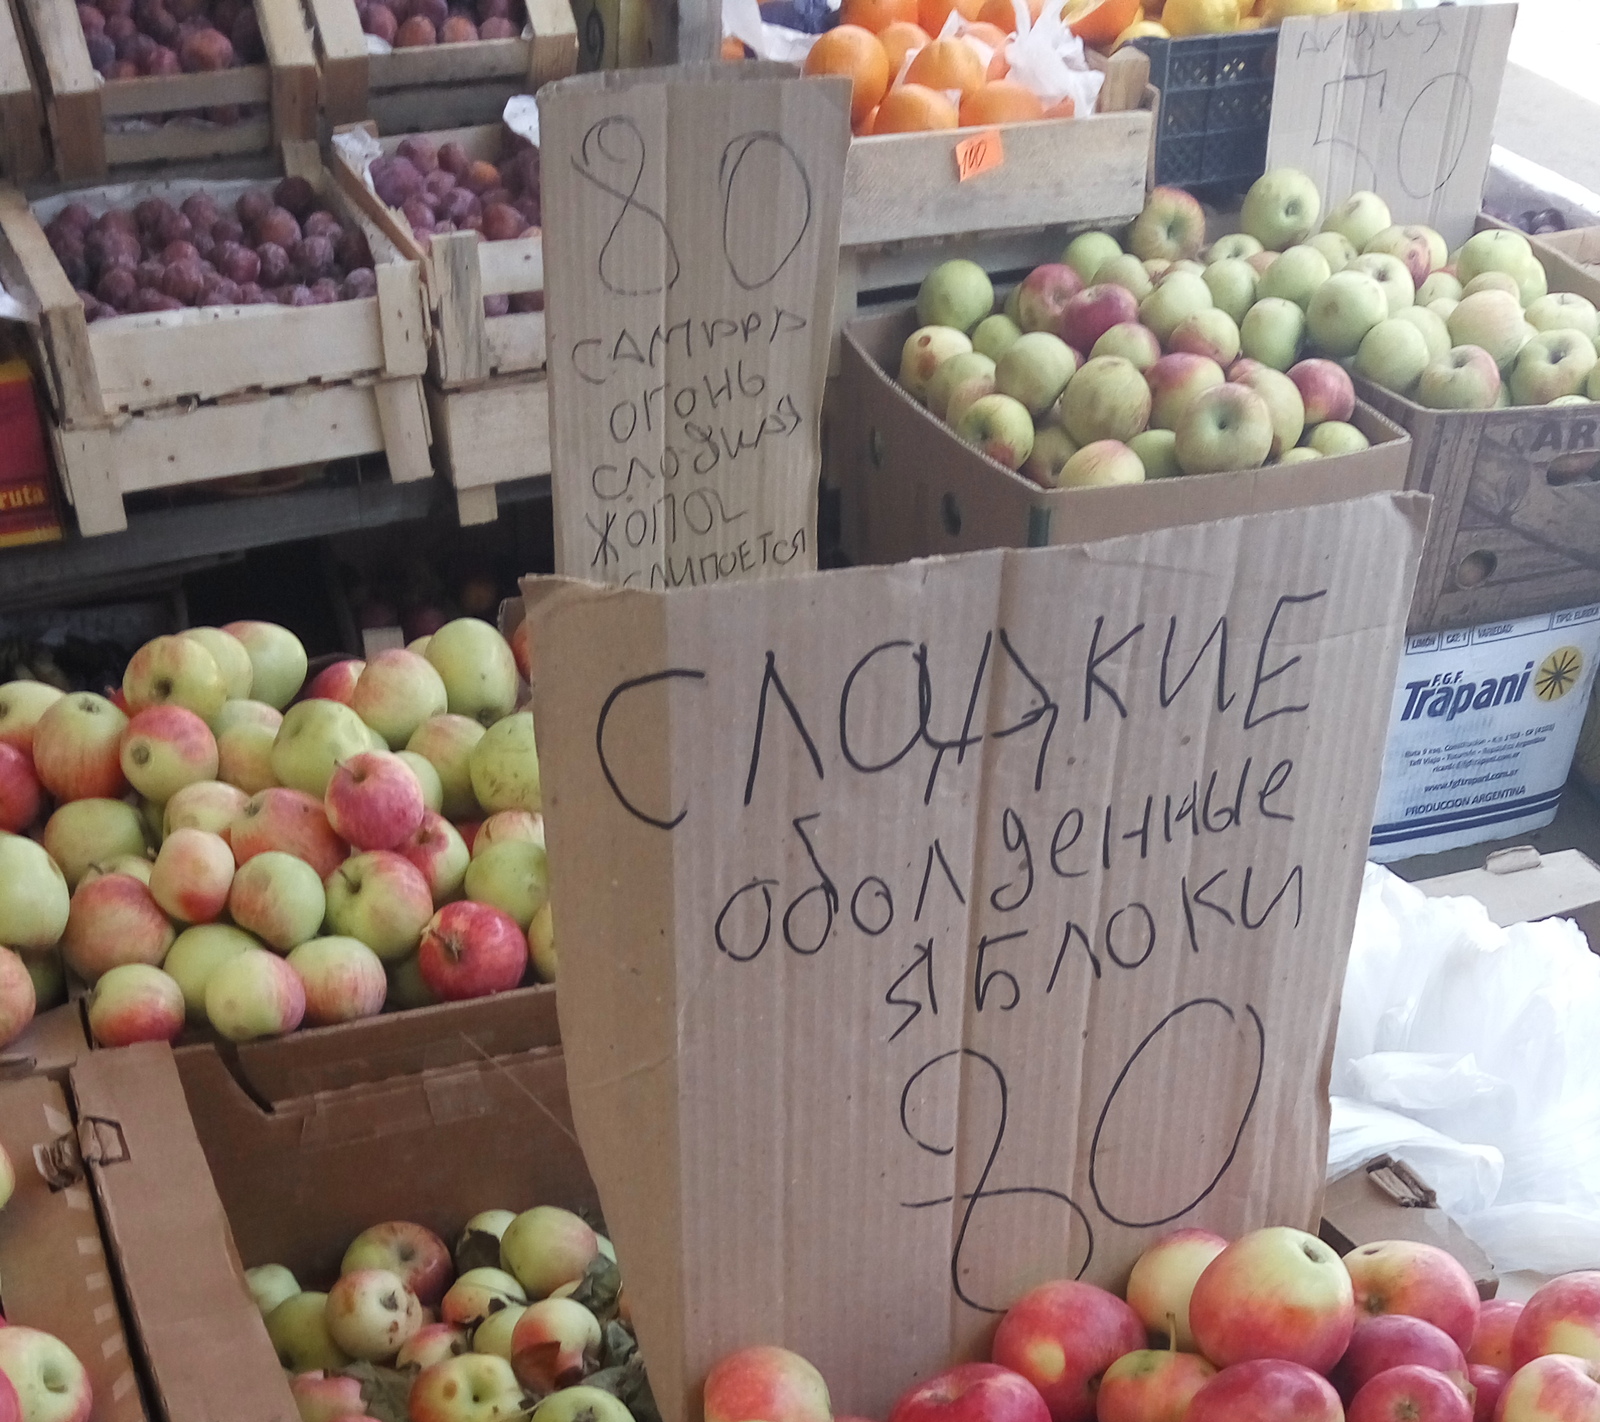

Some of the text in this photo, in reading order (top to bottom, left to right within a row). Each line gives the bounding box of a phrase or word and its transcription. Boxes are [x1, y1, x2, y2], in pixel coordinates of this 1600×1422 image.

[1313, 69, 1473, 200] 50
[571, 115, 811, 296] 80
[609, 360, 766, 444] ОГОНЬ
[1400, 660, 1535, 722] Trapani
[1471, 785, 1526, 805] ARGENTINA
[885, 864, 1303, 1042] ЯБЛОКИ
[900, 998, 1265, 1313] 80
